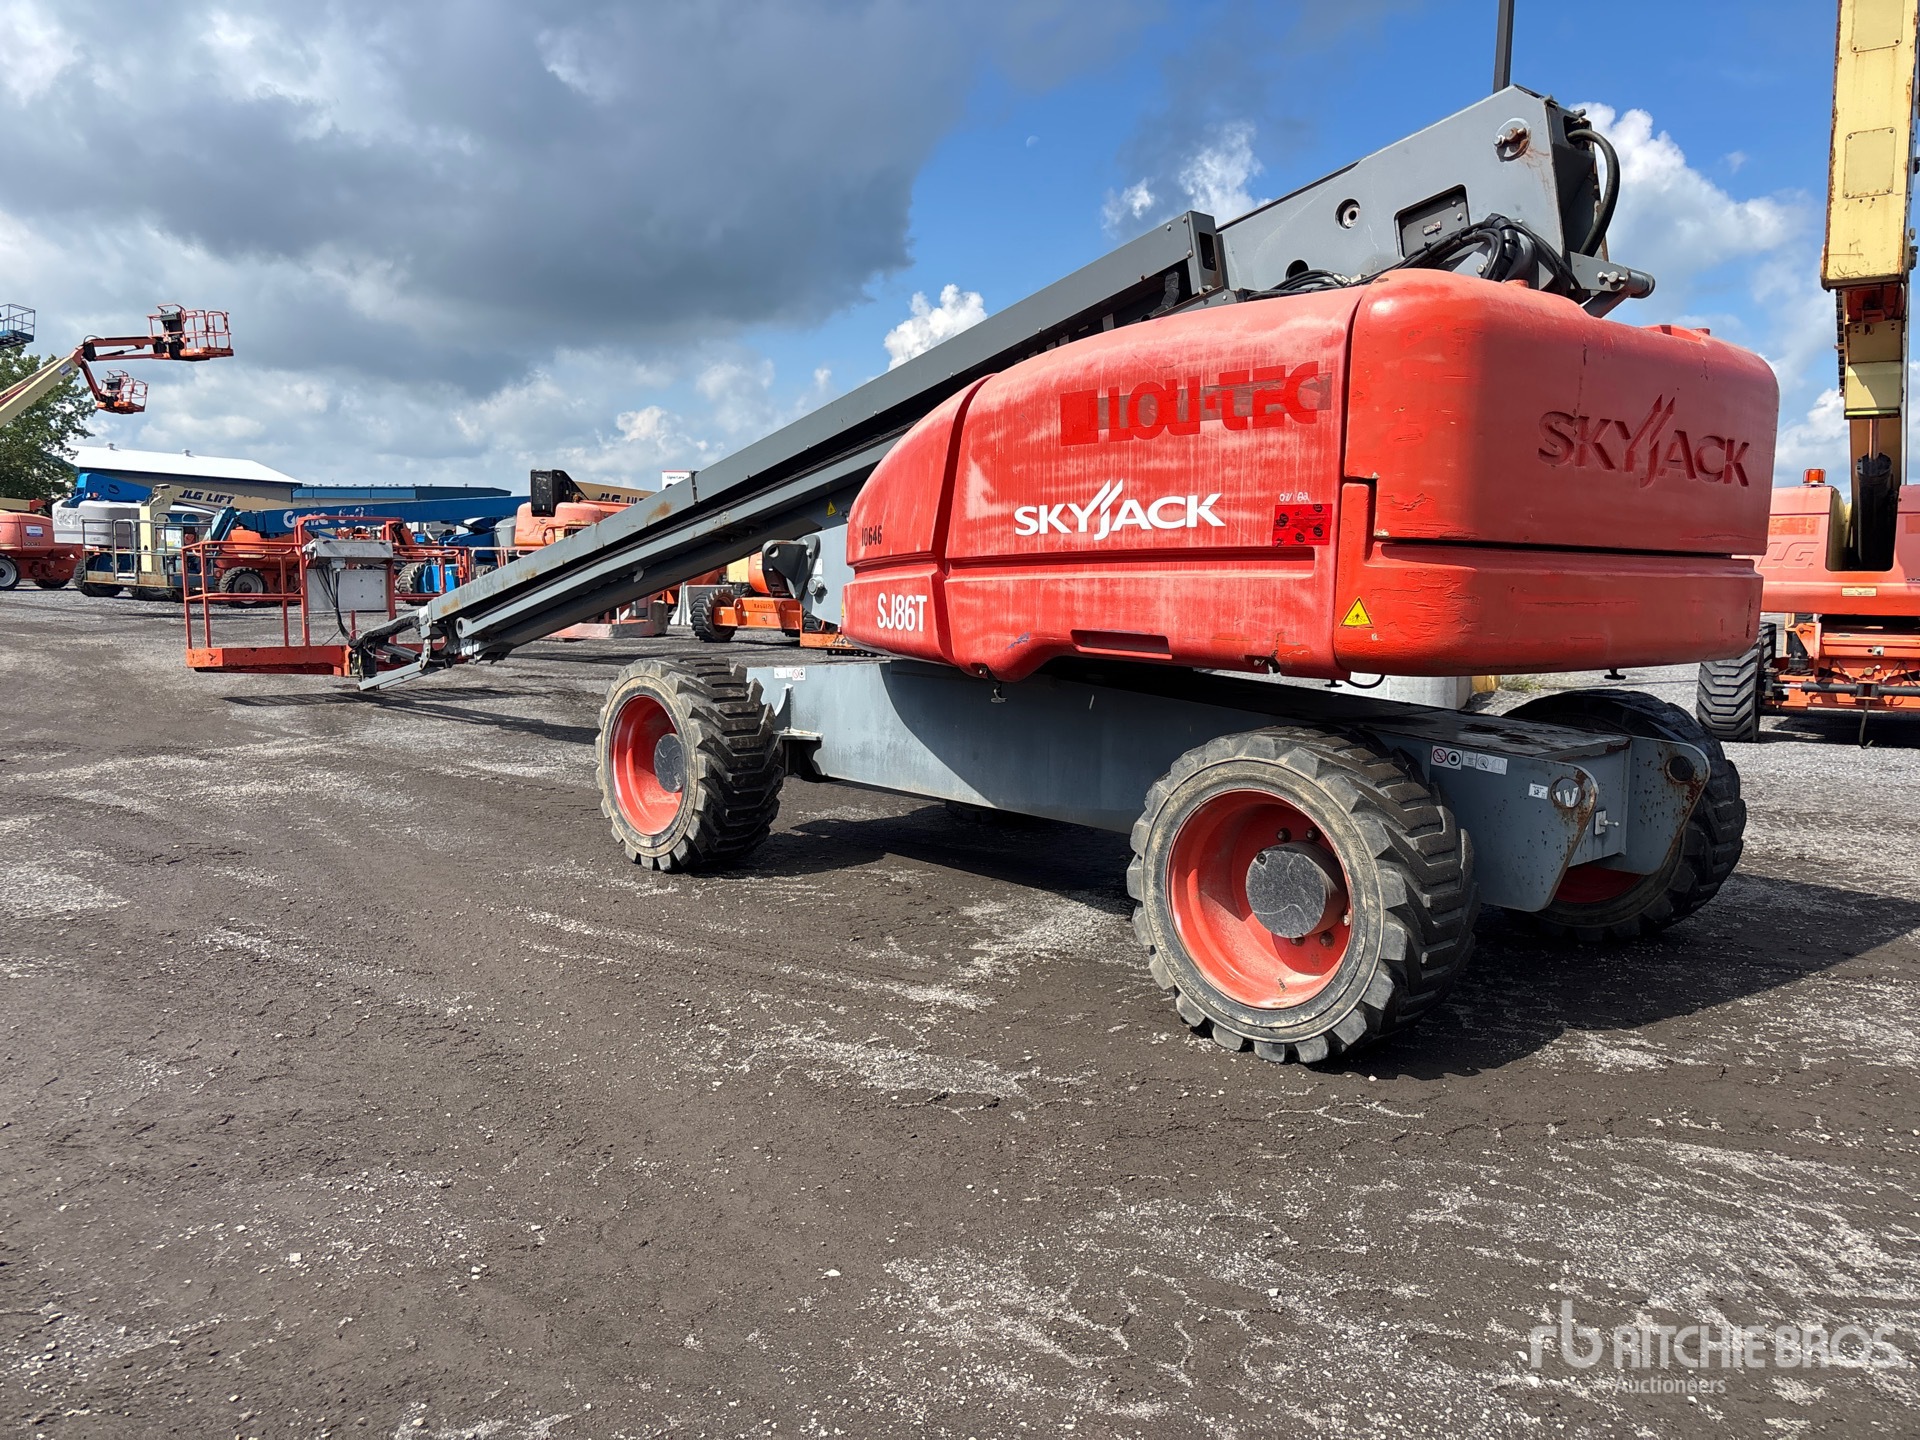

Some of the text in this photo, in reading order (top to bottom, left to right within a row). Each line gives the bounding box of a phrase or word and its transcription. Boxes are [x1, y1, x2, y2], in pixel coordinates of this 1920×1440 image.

[1107, 361, 1318, 442] LOU-TEC
[1538, 393, 1750, 488] SKYJACK
[179, 490, 235, 504] JLG LIFT
[1014, 478, 1226, 541] SKYJACK
[861, 525, 882, 547] 10646
[877, 592, 928, 632] SJ86T
